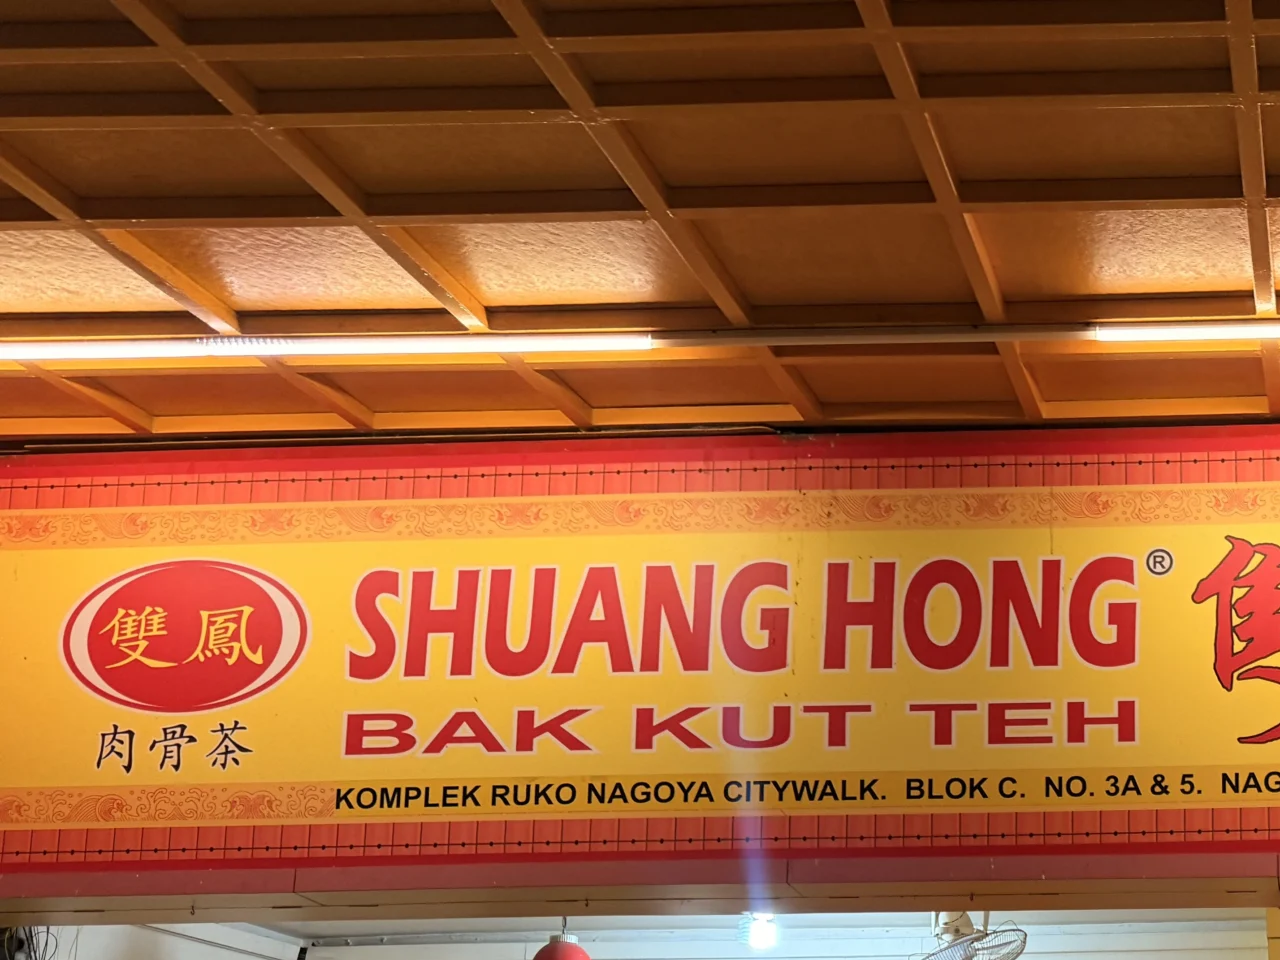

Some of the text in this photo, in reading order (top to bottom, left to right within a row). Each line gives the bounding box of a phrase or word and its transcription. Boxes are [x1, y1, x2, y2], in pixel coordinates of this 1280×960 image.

[98, 604, 265, 669] 雙鳳
[347, 561, 791, 681] SHUANG
[822, 556, 1138, 672] HONG
[96, 720, 254, 774] 肉骨茶
[343, 699, 1137, 757] BAK KUT TEH
[335, 784, 482, 810] KOMPLEK
[491, 782, 577, 807] RUKO
[586, 780, 715, 805] NAGOYA
[722, 778, 888, 803] CITYWALK.
[905, 776, 990, 800] BLOK
[997, 776, 1027, 799] C.
[1044, 775, 1096, 798] NO.
[1104, 774, 1143, 797] 3A
[1149, 773, 1171, 796] &
[1179, 773, 1203, 796] 5.
